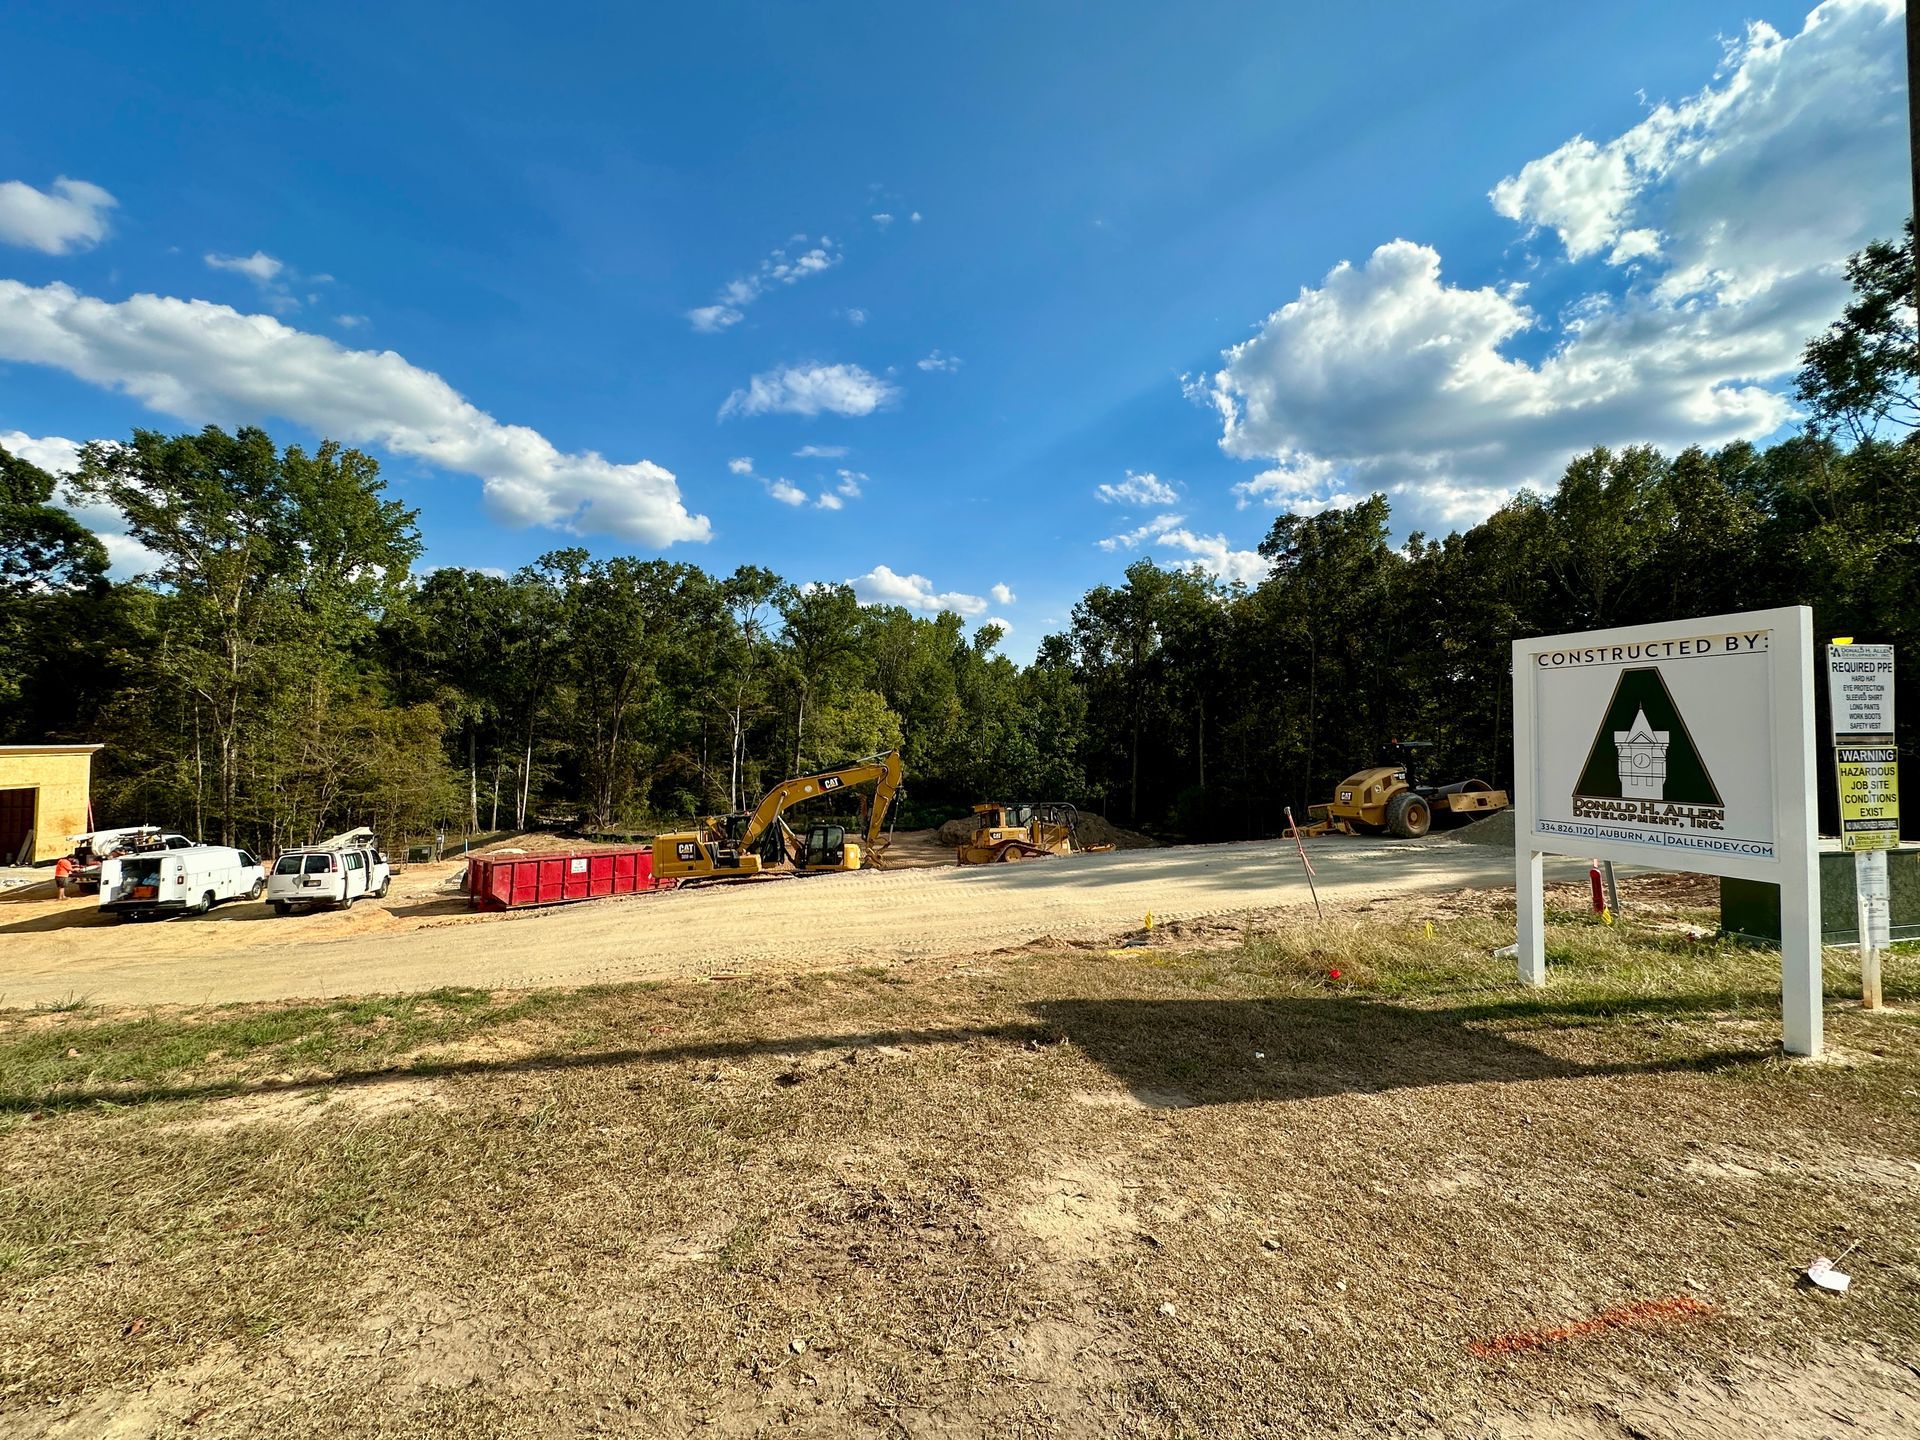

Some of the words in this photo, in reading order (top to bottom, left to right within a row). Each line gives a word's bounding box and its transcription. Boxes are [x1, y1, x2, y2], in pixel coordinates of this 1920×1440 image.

[1538, 639, 1711, 666] CONSTRUCTED
[1725, 633, 1768, 651] BY:
[1832, 662, 1875, 673] REQUIRED
[1877, 662, 1893, 673] PPE
[1841, 750, 1894, 761] WARNING
[1840, 767, 1895, 776] HAZARDOUS
[825, 778, 838, 789] CAT
[1851, 781, 1868, 790] JOB
[1871, 781, 1889, 789] SITE
[1341, 792, 1351, 800] CAT
[1845, 794, 1896, 803] CONDITIONS
[1573, 799, 1637, 814] DONALD
[1640, 802, 1660, 815] H.
[1663, 804, 1724, 820] ALLEN
[1860, 808, 1884, 816] EXIST
[1573, 808, 1684, 828] DEVELOPMENT,
[1690, 817, 1724, 830] INC.
[1541, 823, 1594, 836] 334.826.1120
[1600, 829, 1645, 842] AUBURN,
[1648, 834, 1662, 843] AL
[1667, 836, 1773, 855] DALLENDEV.COM
[679, 844, 694, 854] CAT
